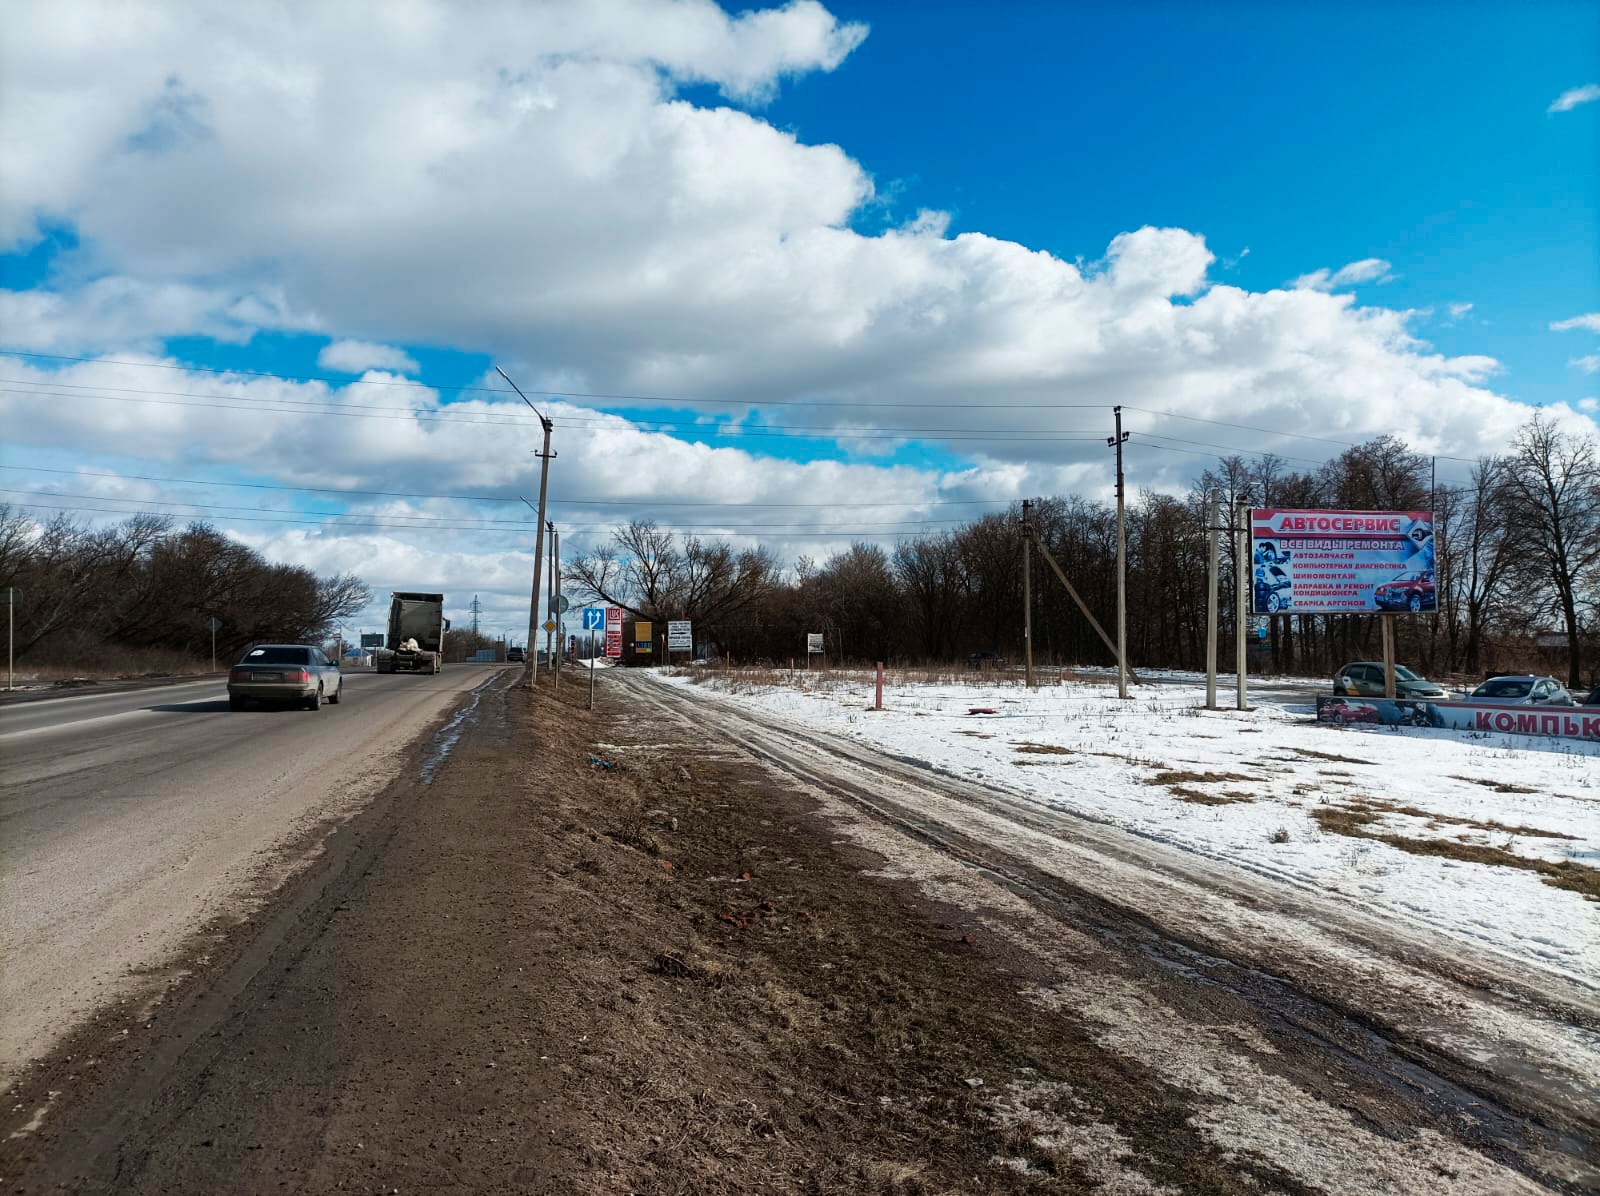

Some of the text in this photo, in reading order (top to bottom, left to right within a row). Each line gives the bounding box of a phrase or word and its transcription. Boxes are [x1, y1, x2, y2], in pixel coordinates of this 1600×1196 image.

[1280, 517, 1400, 532] АВТОСЕРВИС
[1280, 540, 1404, 551] ВСЕ ВИДЫ РЕМОНТА
